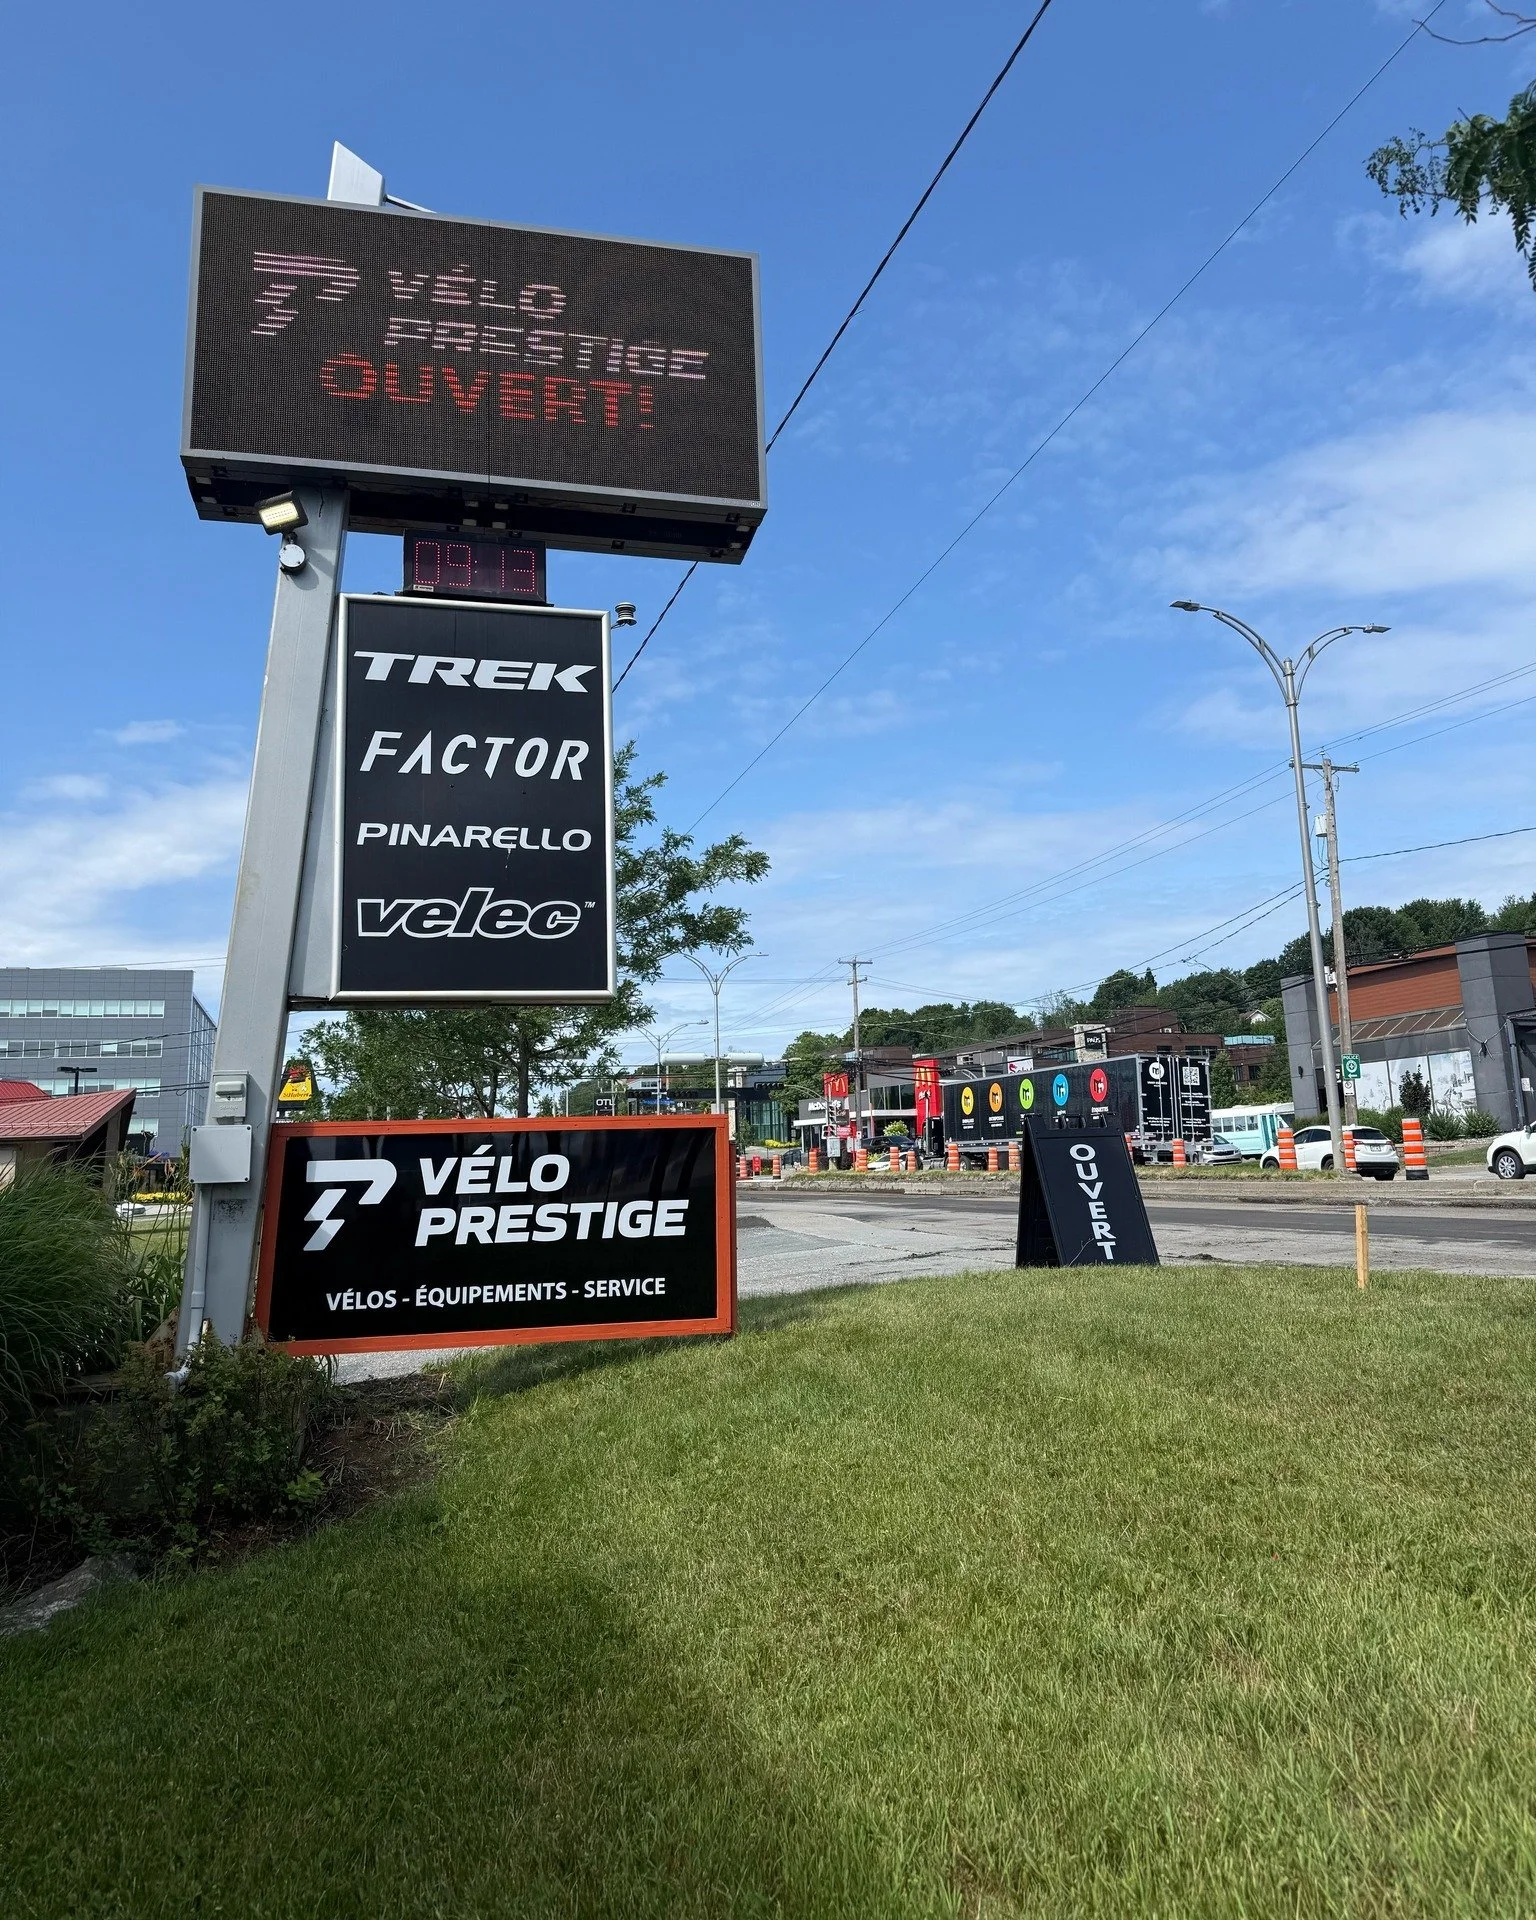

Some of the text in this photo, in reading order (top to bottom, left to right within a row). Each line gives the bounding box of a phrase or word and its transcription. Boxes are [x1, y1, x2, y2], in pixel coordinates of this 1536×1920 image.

[388, 263, 567, 319] VÉLO
[384, 317, 709, 379] PRESTIGE
[319, 351, 653, 429] OUVERT!
[415, 541, 535, 592] 09:13
[353, 650, 597, 693] TREK
[359, 730, 590, 781] FACTOR
[356, 822, 592, 852] PINARELLO
[357, 887, 581, 939] velec
[419, 1144, 570, 1196] VÉLO
[414, 1199, 690, 1247] PRESTIGE
[1069, 1143, 1116, 1260] OUVERT
[326, 1288, 397, 1311] VÉLOS
[415, 1280, 567, 1308] ÉQUIPEMENTS
[584, 1277, 666, 1299] SERVICE
